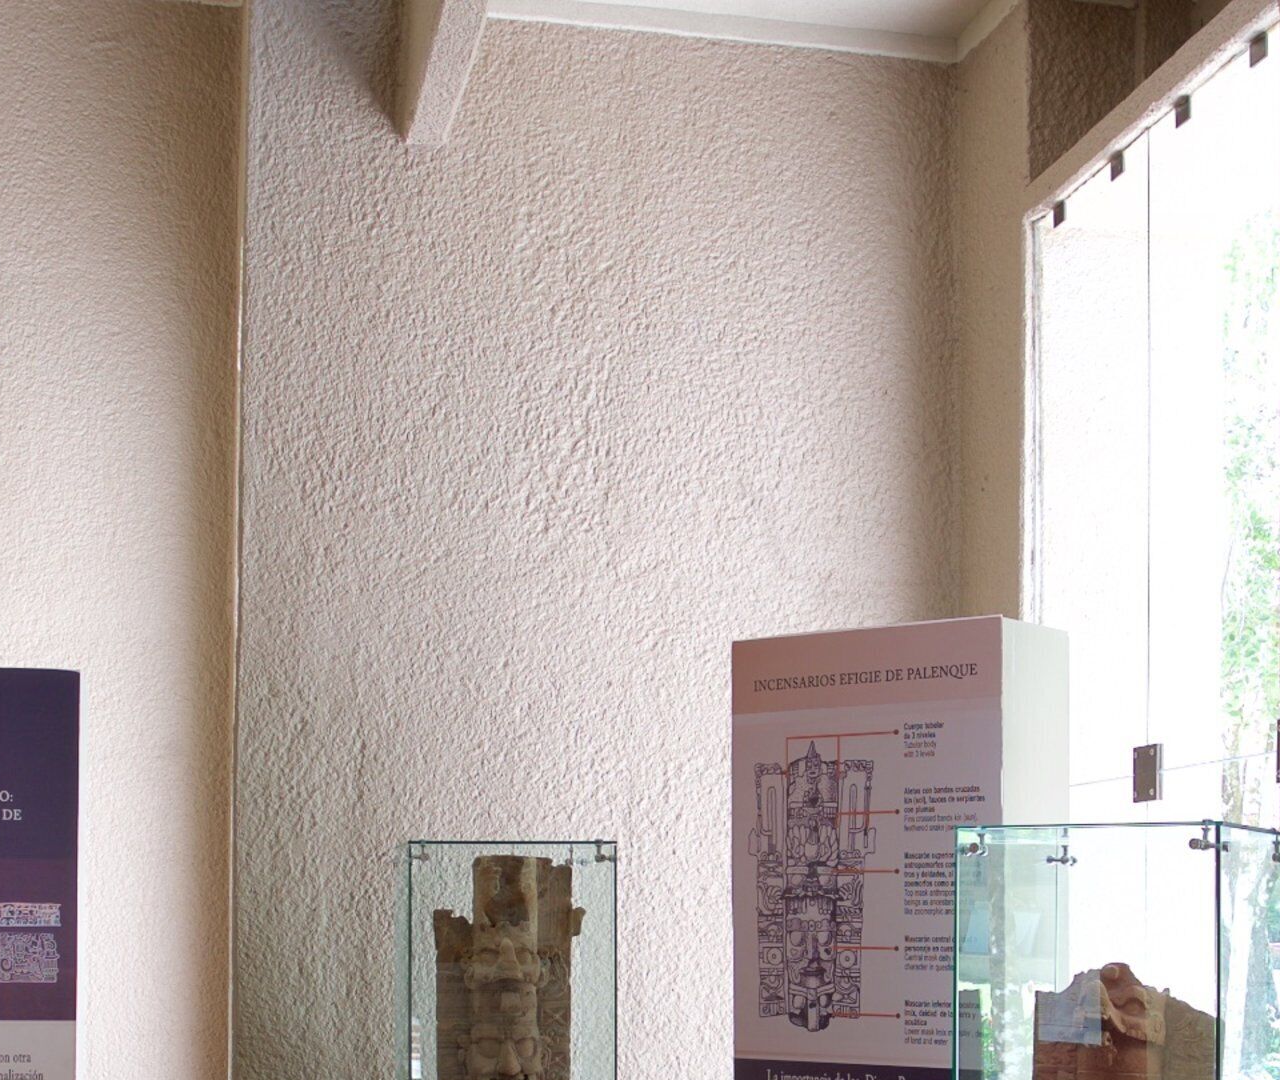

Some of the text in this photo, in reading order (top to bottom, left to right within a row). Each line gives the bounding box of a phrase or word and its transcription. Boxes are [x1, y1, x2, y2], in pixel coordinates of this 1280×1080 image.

[753, 663, 978, 692] INCENSARIOS EFIGIE DE PALENQUE
[2, 808, 22, 820] DE
[12, 1052, 31, 1063] otra
